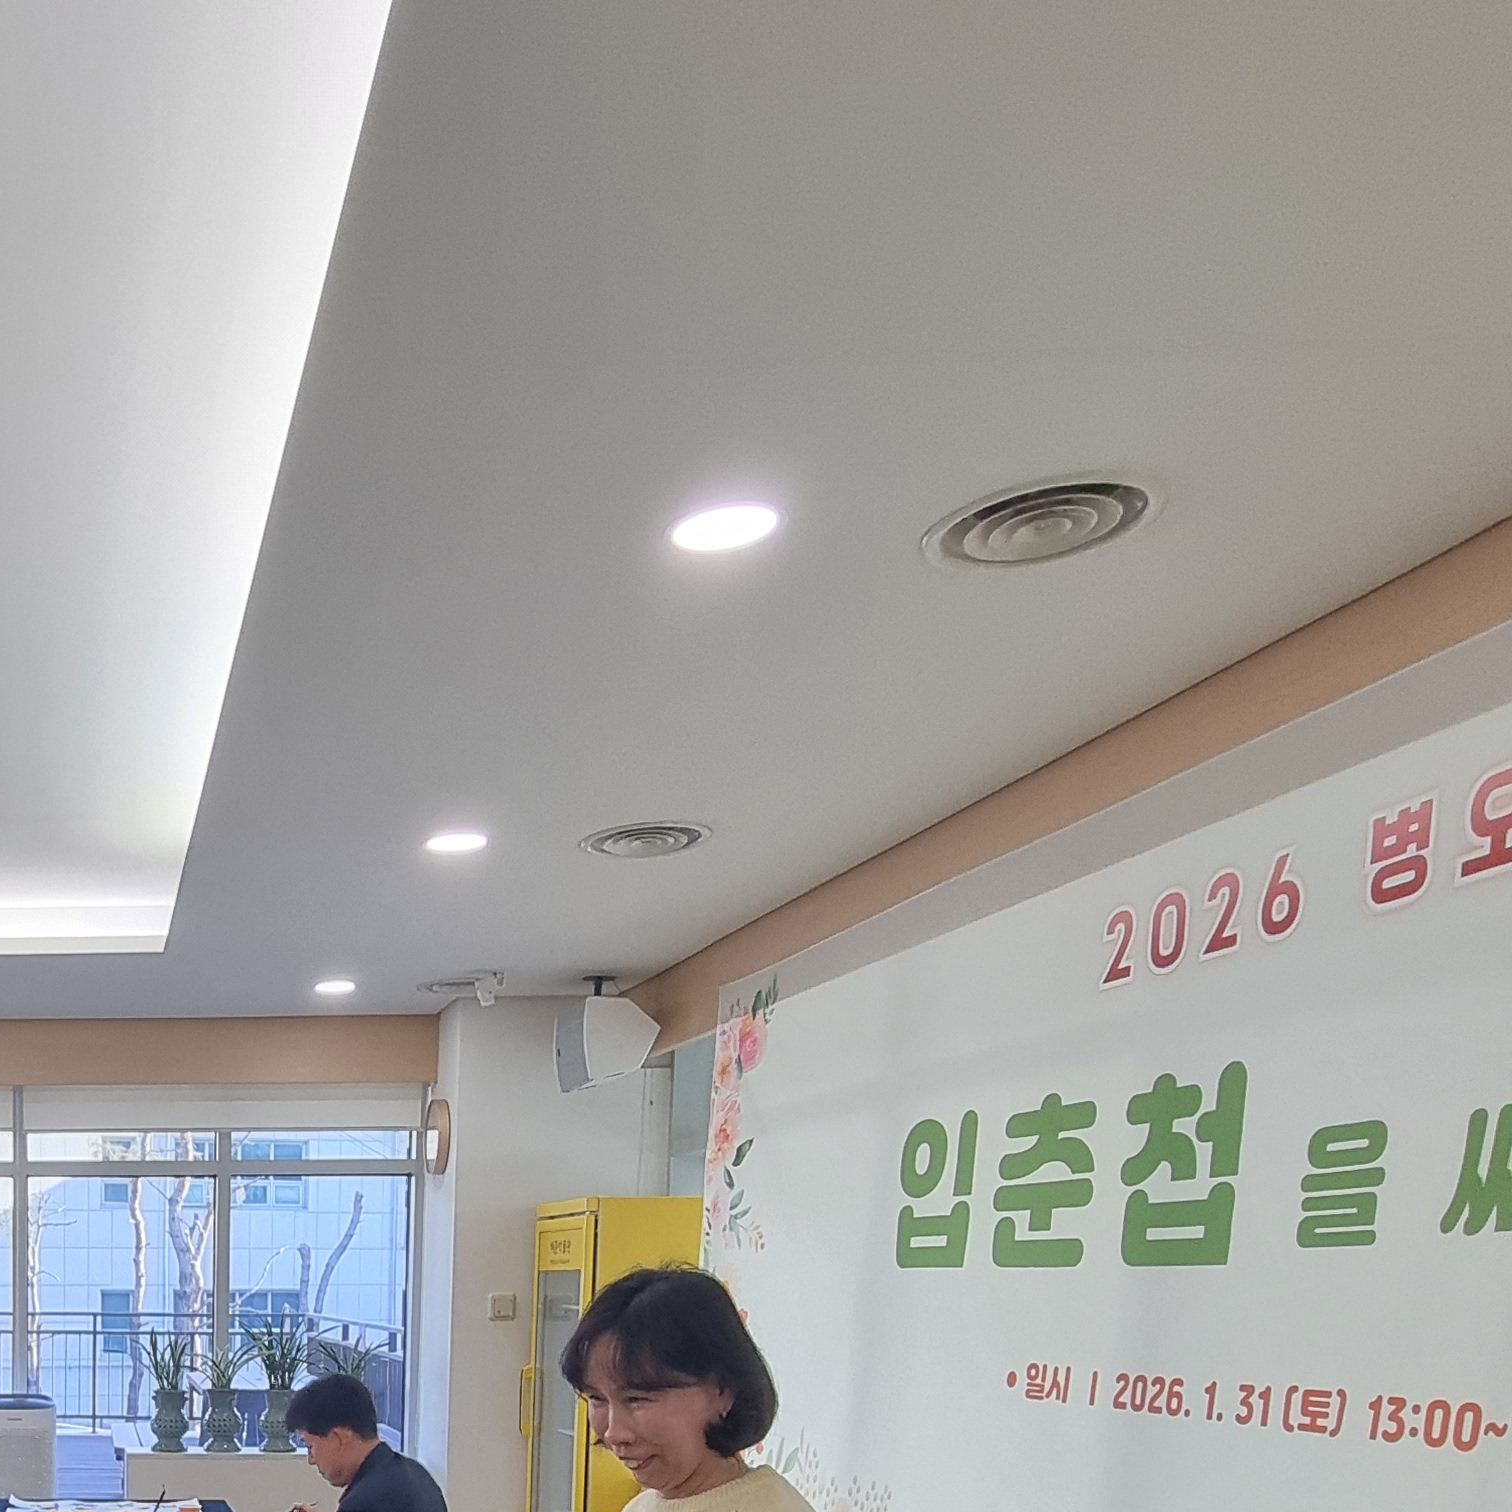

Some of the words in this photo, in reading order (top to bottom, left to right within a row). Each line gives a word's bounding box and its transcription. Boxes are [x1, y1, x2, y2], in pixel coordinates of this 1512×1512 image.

[1102, 852, 1301, 985] 2026
[896, 1060, 1248, 1269] 입춘첩
[1025, 1362, 1071, 1404] 일시
[1112, 1372, 1190, 1418] 2026.
[1204, 1380, 1223, 1422] 1.
[1368, 1394, 1508, 1452] 13:00~
